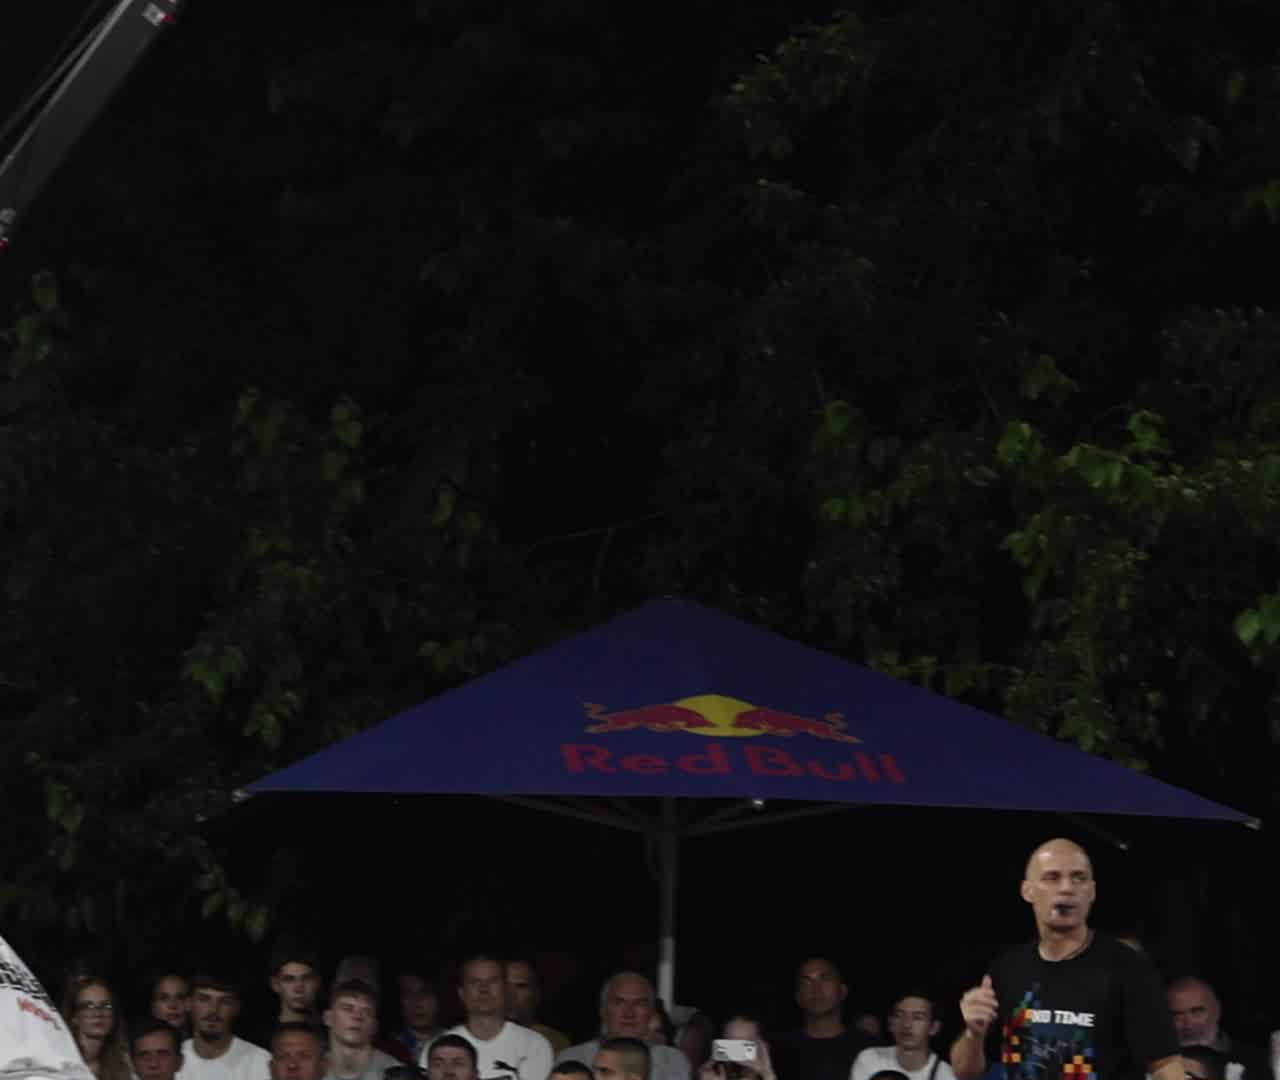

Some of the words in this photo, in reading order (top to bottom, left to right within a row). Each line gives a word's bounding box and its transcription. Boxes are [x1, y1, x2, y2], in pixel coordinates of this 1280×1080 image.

[560, 743, 735, 776] Red
[742, 745, 907, 784] Bull
[1054, 1010, 1096, 1027] TIME
